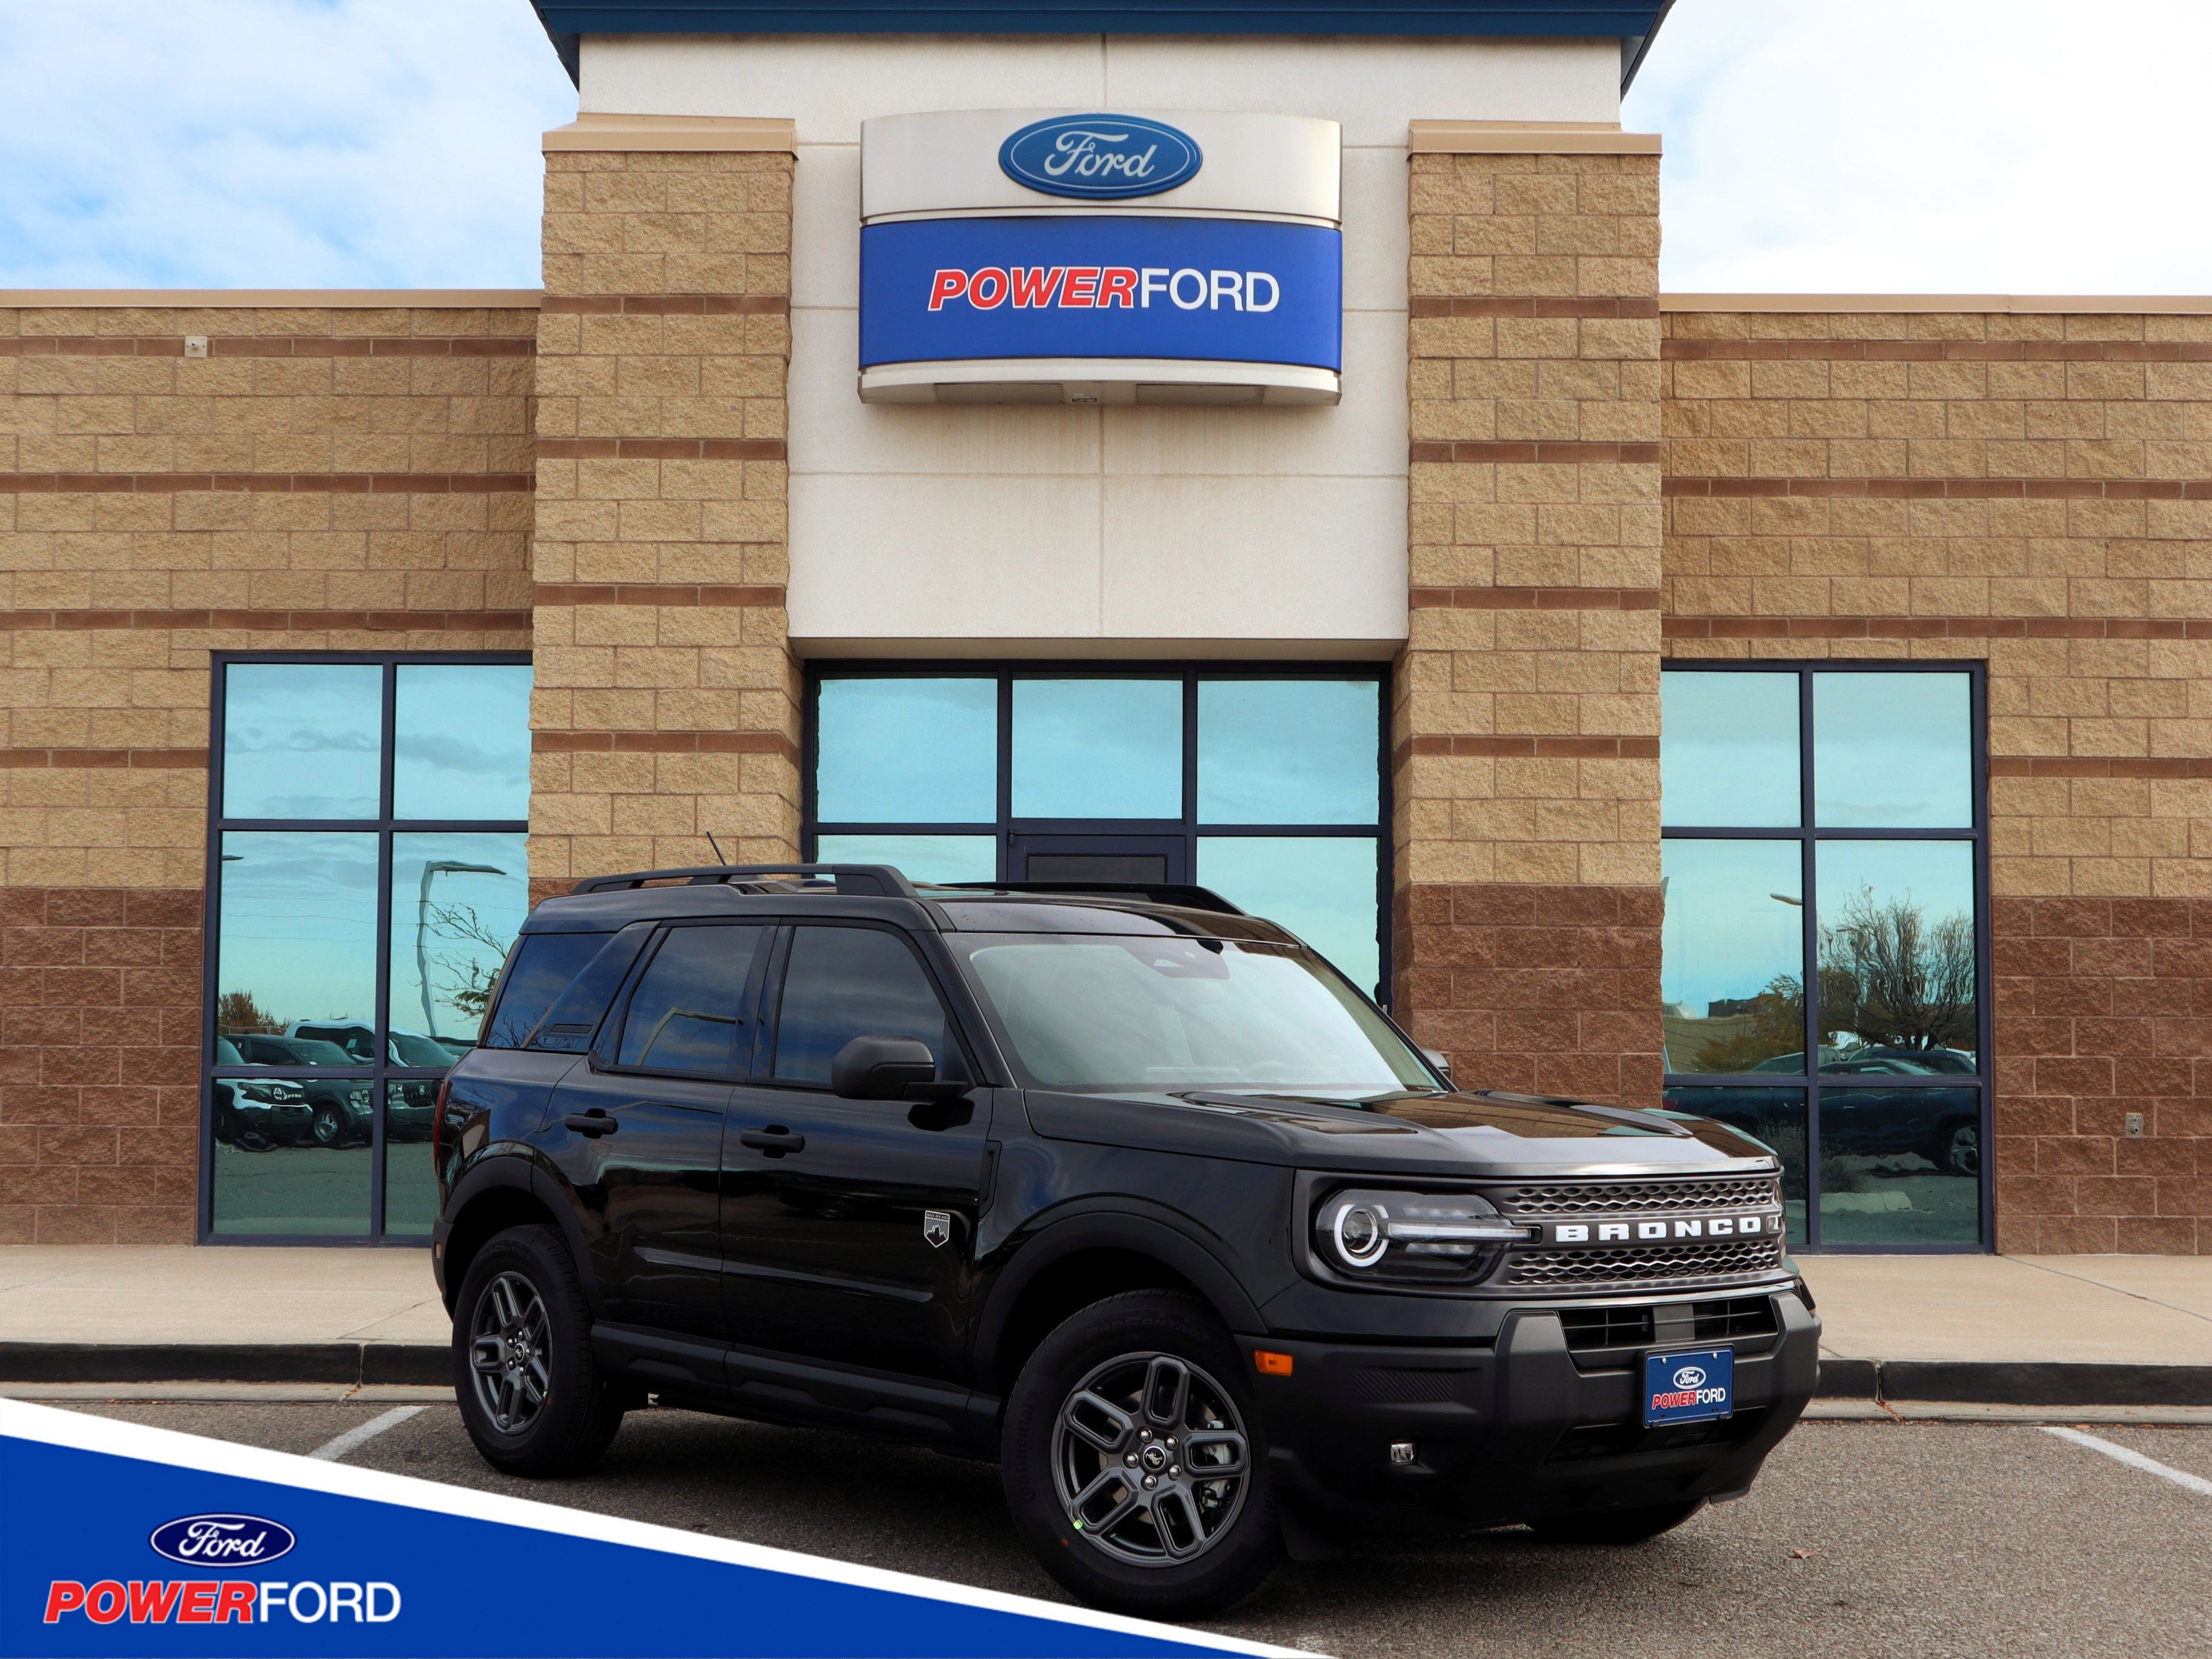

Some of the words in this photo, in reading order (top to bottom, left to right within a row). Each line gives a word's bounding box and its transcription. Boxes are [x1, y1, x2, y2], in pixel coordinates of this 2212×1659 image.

[1045, 130, 1157, 178] Ford
[1555, 1217, 1761, 1243] BRONCO
[1679, 1371, 1699, 1385] Ford
